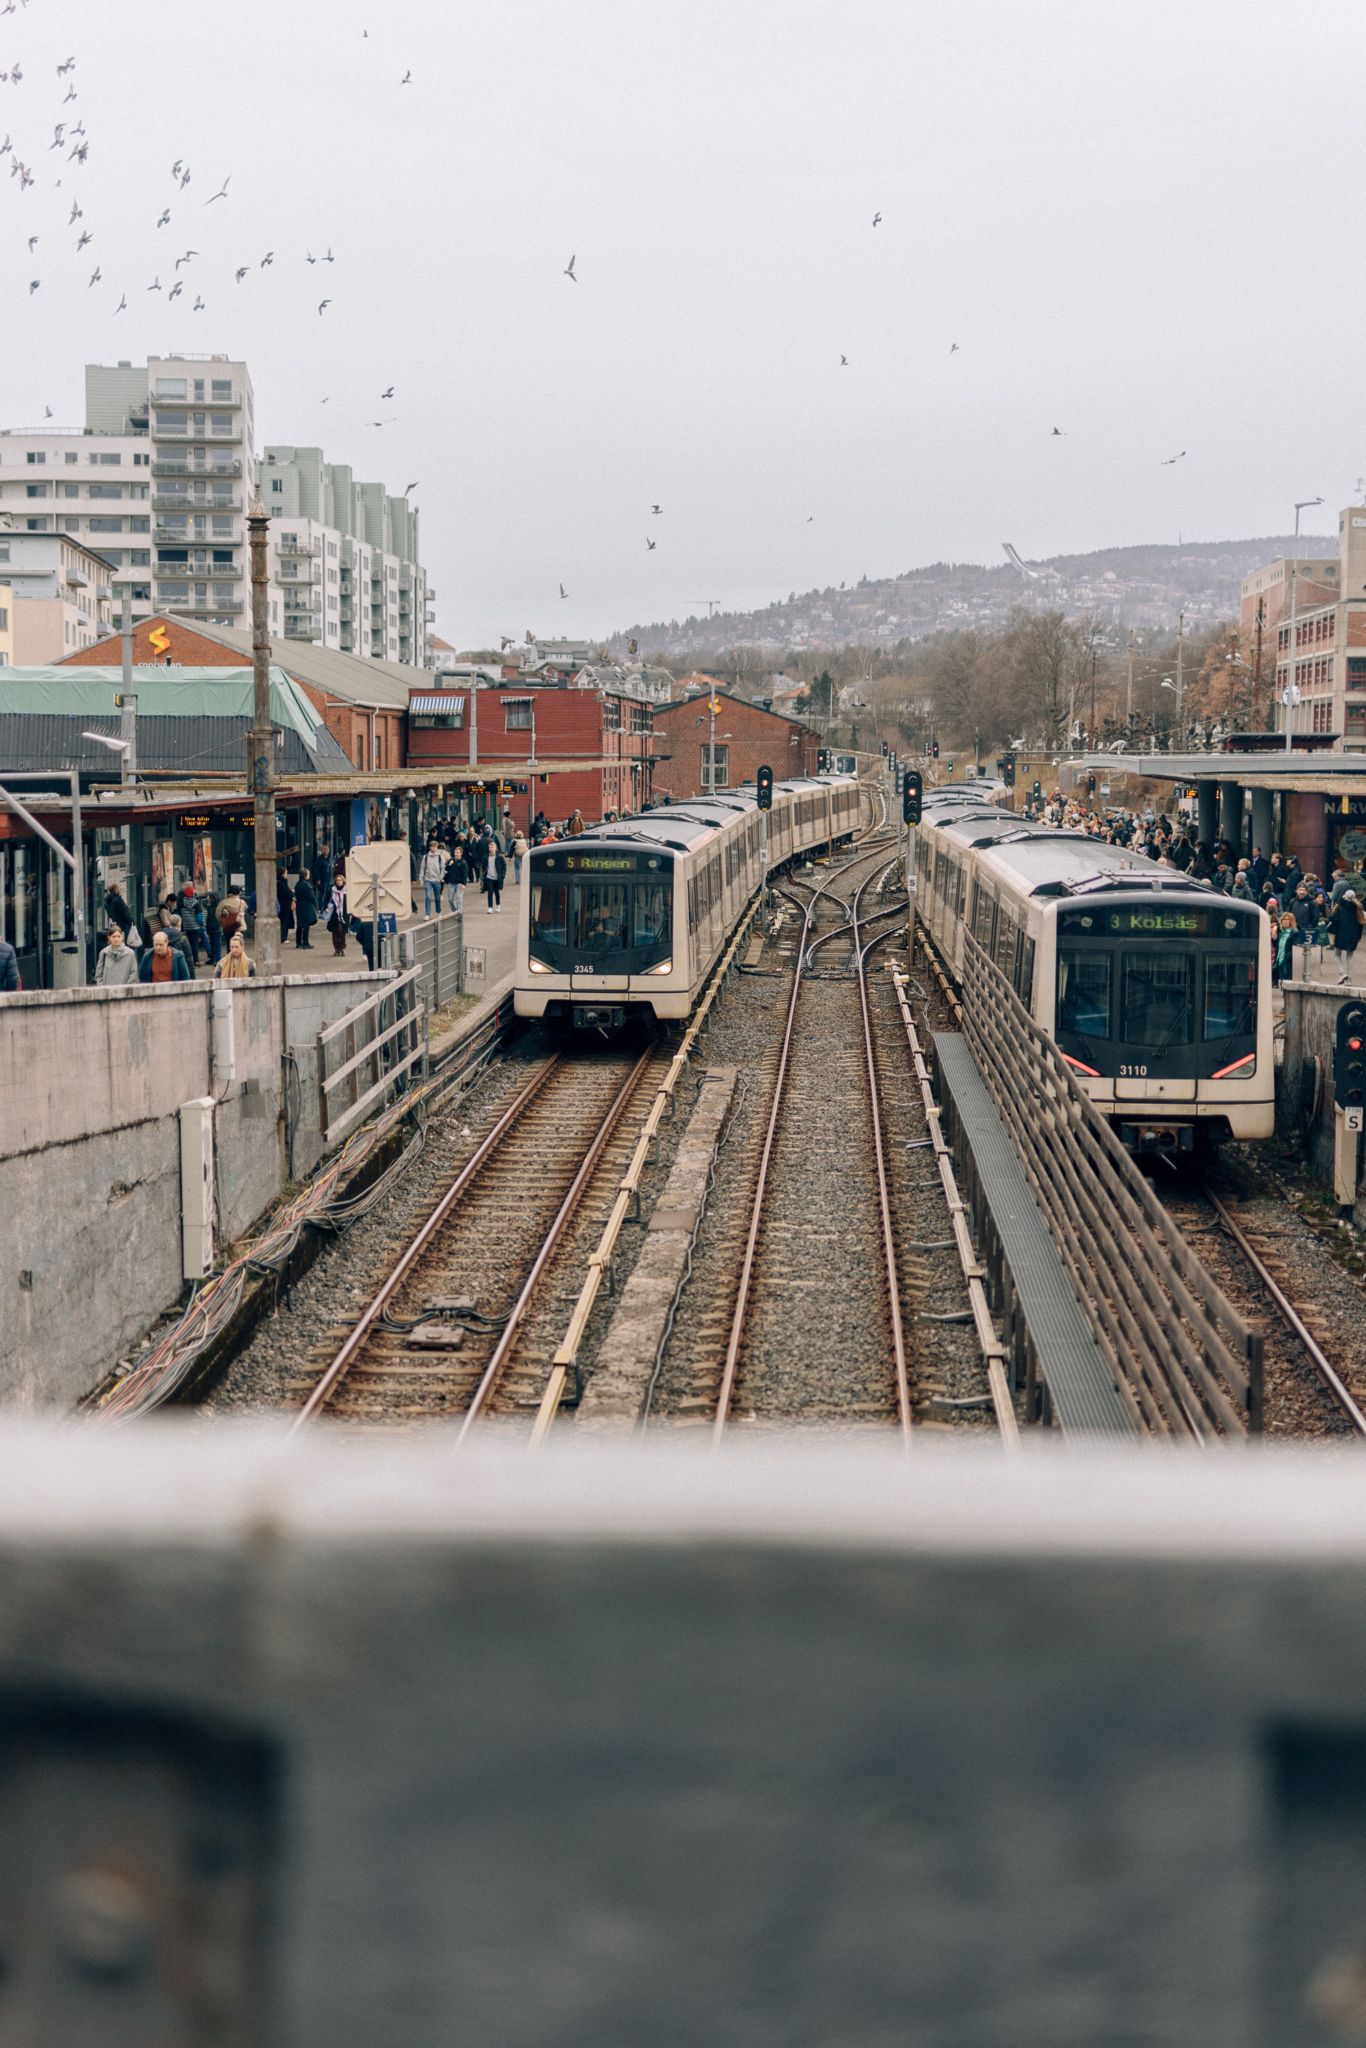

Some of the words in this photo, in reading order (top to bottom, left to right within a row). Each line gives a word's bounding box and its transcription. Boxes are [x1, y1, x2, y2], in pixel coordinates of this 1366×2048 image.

[567, 857, 574, 869] 5
[581, 858, 631, 869] Ringen
[909, 879, 915, 887] S
[384, 921, 390, 933] 1
[1111, 914, 1120, 929] 3
[1130, 914, 1198, 929] Kolsås
[1303, 934, 1313, 945] 3
[574, 965, 594, 974] 3345
[1120, 1065, 1147, 1076] 3110
[1348, 1115, 1358, 1129] S
